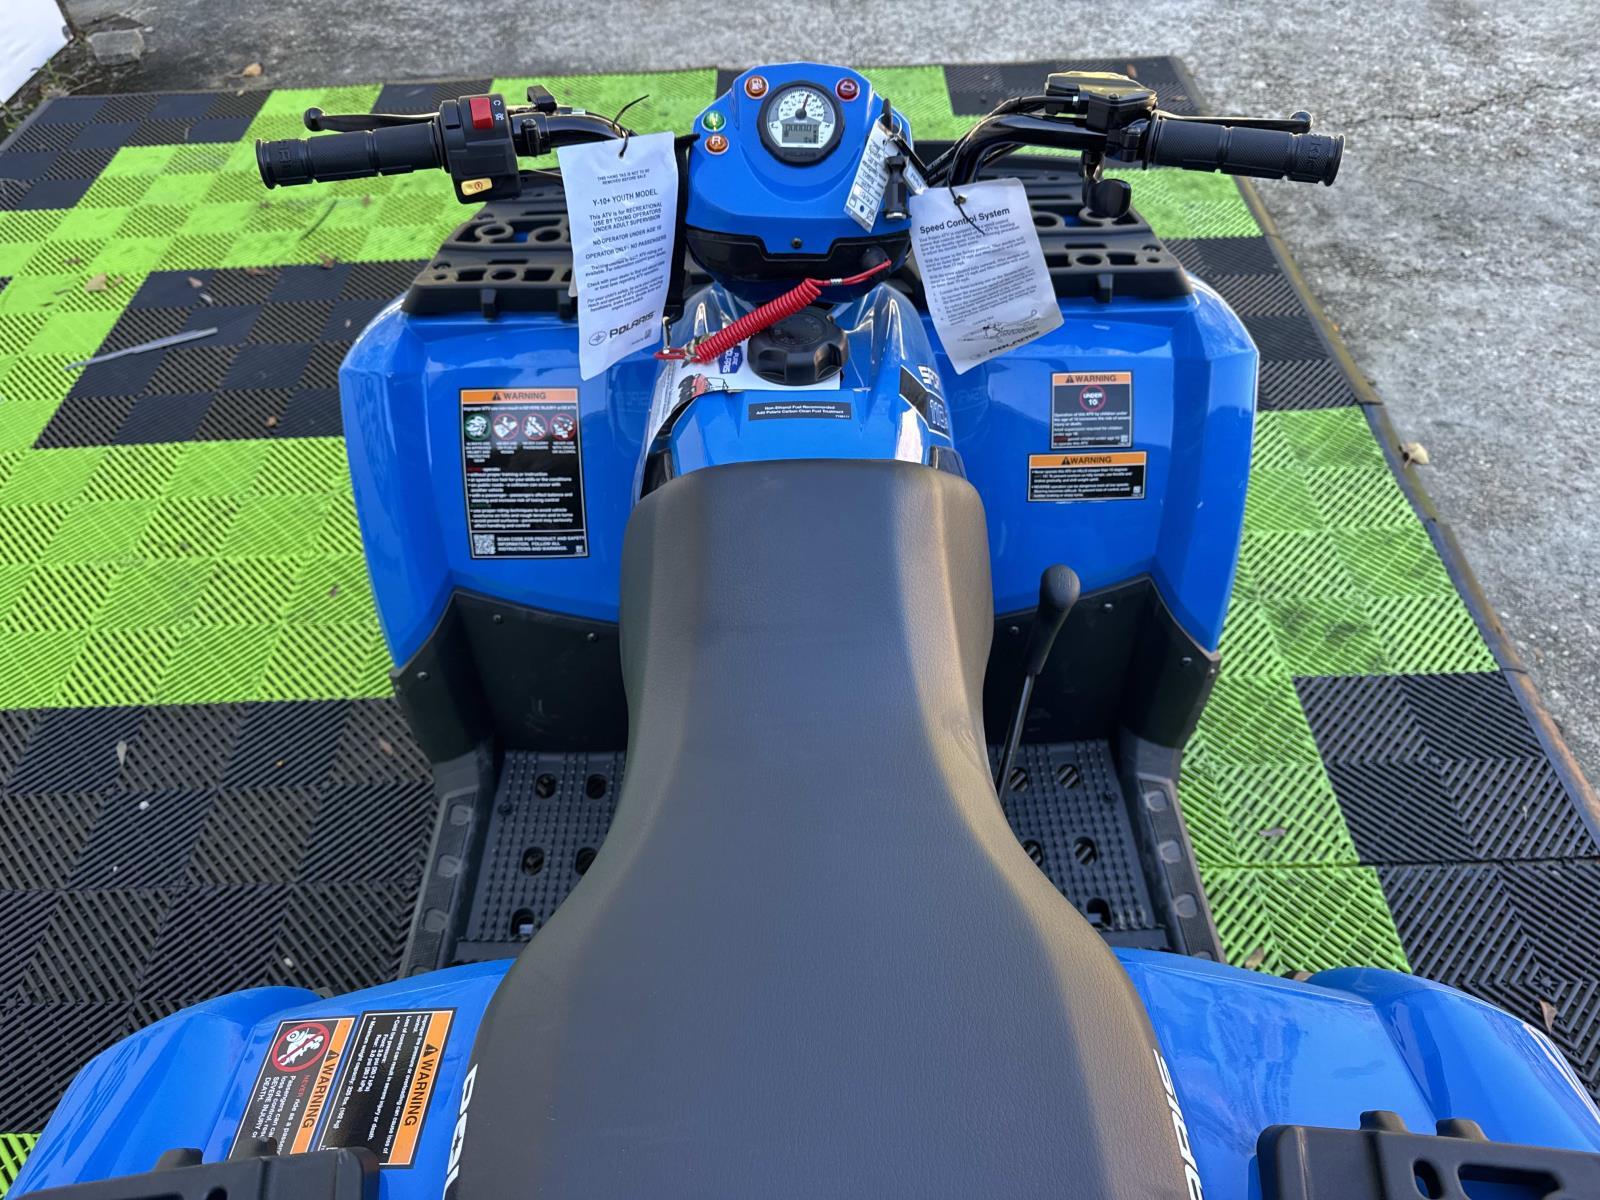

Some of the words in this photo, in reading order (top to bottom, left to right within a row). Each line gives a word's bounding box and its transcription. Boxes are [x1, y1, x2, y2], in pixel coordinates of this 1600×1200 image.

[712, 135, 721, 145] R
[592, 196, 610, 206] Y-10+
[611, 192, 633, 203] YOUTH
[635, 187, 658, 198] MODEL
[593, 218, 604, 226] USE
[613, 213, 631, 222] YOUNG
[632, 207, 661, 219] OPERATORS
[625, 201, 662, 213] RECREATIONAL
[592, 223, 611, 233] UNDER
[612, 220, 629, 229] ADULT
[629, 214, 660, 225] SUPERVISION
[920, 223, 944, 235] Speed
[978, 208, 1010, 221] System
[592, 238, 601, 246] NO
[601, 233, 628, 244] OPERATOR
[629, 229, 645, 237] UNDER
[585, 248, 614, 259] OPERATOR
[609, 310, 656, 339] POLARIS
[503, 392, 546, 400] WARNING
[1070, 456, 1112, 465] WARNING
[255, 1076, 271, 1102] DEATH.
[264, 1076, 279, 1102] SEVERE
[277, 1075, 288, 1089] loss
[275, 1075, 296, 1112] Passengers
[301, 1063, 335, 1128] WARNING
[403, 1059, 434, 1126] WARNING
[263, 1097, 279, 1123] control,
[290, 1098, 301, 1112] ride
[253, 1103, 269, 1129] INJURY
[271, 1113, 281, 1125] can
